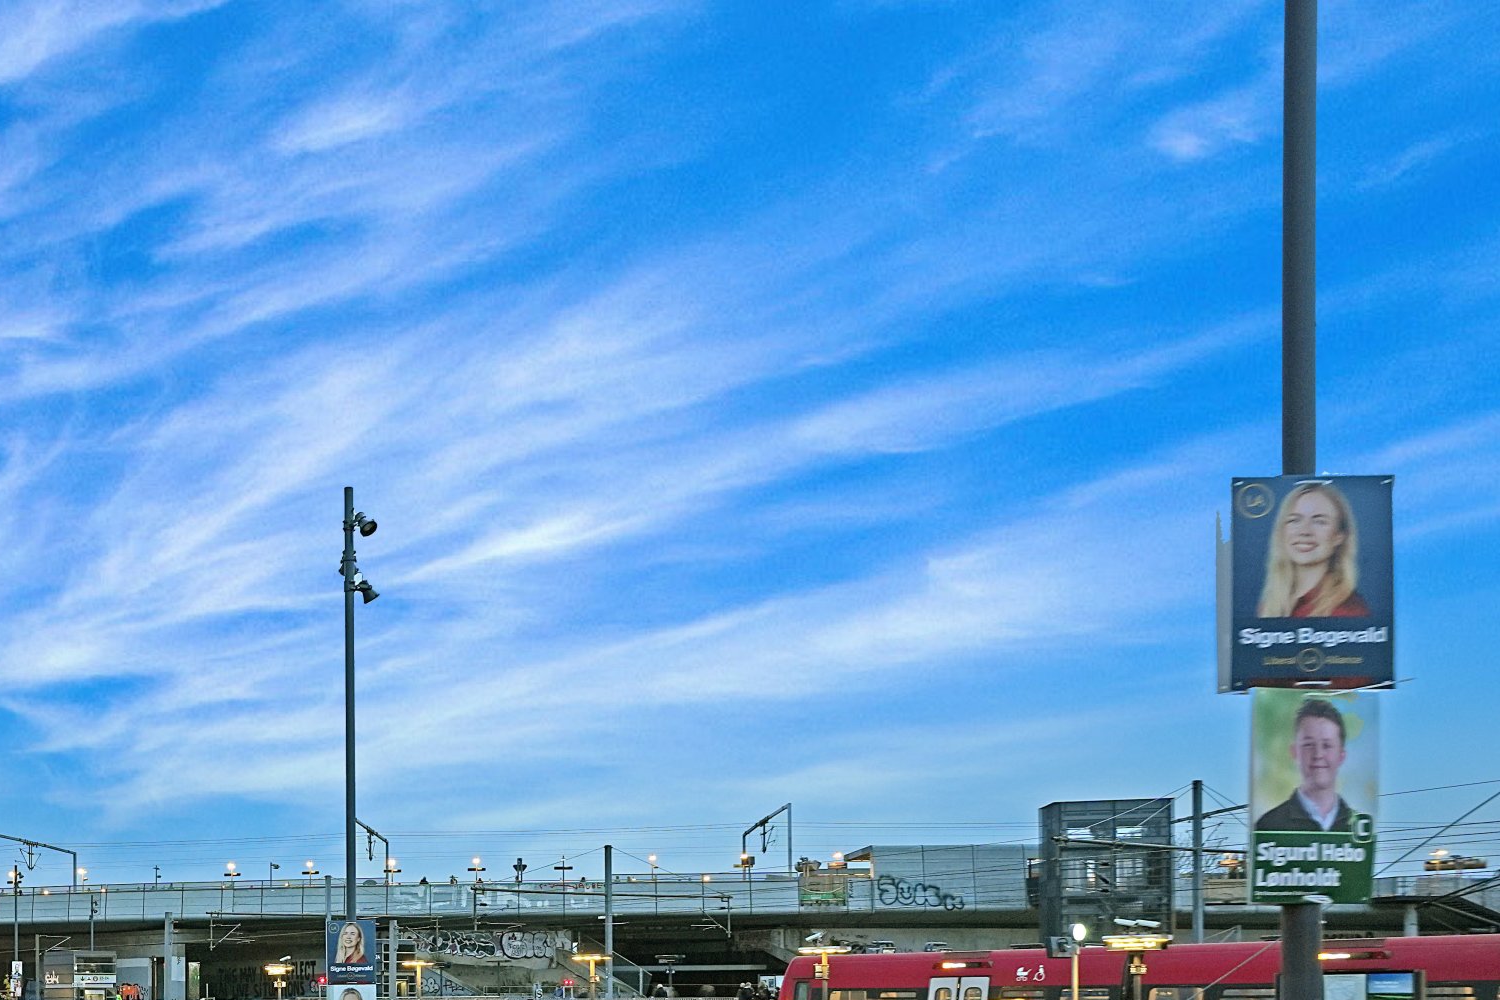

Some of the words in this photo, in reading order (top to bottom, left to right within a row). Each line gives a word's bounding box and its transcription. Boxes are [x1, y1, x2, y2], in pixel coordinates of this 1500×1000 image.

[1238, 627, 1296, 648] Signe
[1297, 626, 1389, 648] Bøgevald
[1357, 819, 1370, 836] C
[1257, 842, 1319, 867] Sigurd
[1321, 842, 1367, 862] Hebo
[1255, 867, 1342, 887] Lønholdt
[330, 965, 346, 973] Signe
[347, 965, 374, 973] Bøgevald
